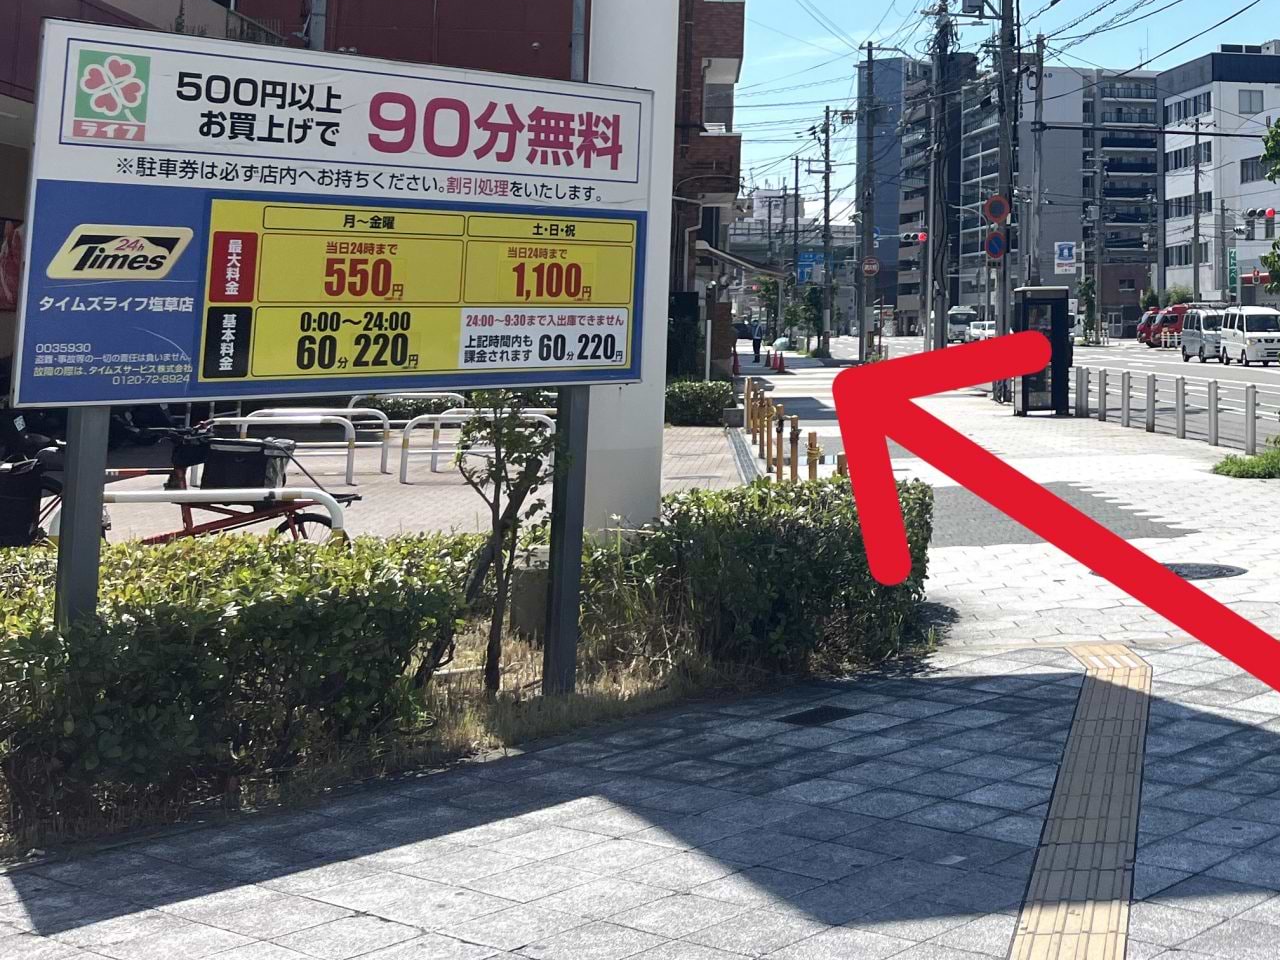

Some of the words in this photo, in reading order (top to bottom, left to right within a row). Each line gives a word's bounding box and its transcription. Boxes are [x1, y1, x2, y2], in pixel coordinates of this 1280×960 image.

[175, 71, 343, 115] 500円以上
[79, 121, 139, 140] ライフ
[198, 110, 341, 147] お買上げで
[367, 91, 623, 171] 90分無料
[114, 238, 145, 252] 24h
[325, 241, 399, 256] 当日24時まで
[507, 246, 568, 260] 当日24時まで
[72, 244, 168, 272] Times
[225, 239, 243, 296] 最大料金
[324, 257, 404, 298] 550円
[39, 296, 195, 313] タイムズライフ塩草店
[35, 343, 91, 353] 0035930
[218, 313, 237, 371] 基本料金
[464, 334, 533, 349] 上記時間内も
[463, 349, 533, 363] 課金されます
[112, 374, 191, 385] 0120-72-8924
